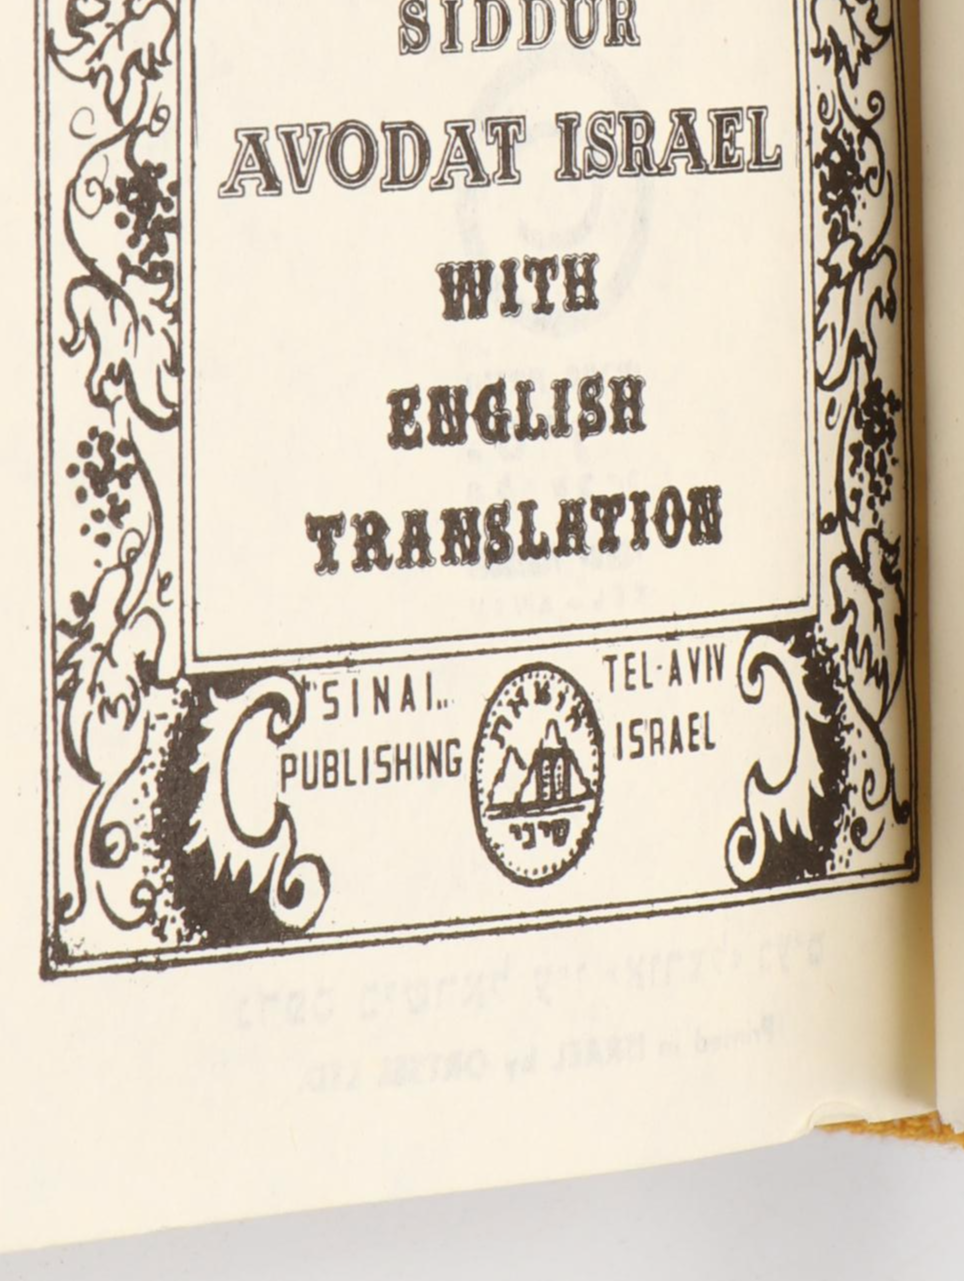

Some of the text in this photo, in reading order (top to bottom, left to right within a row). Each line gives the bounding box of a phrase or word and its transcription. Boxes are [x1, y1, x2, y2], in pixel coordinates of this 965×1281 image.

[218, 105, 782, 198] AVODAT ISRAEL
[436, 253, 599, 321] WITH
[387, 372, 646, 450] ENGLISH
[305, 485, 722, 575] TRANSLATION
[279, 735, 462, 792] PUBLISHING
[616, 711, 715, 760] ISRAEL
